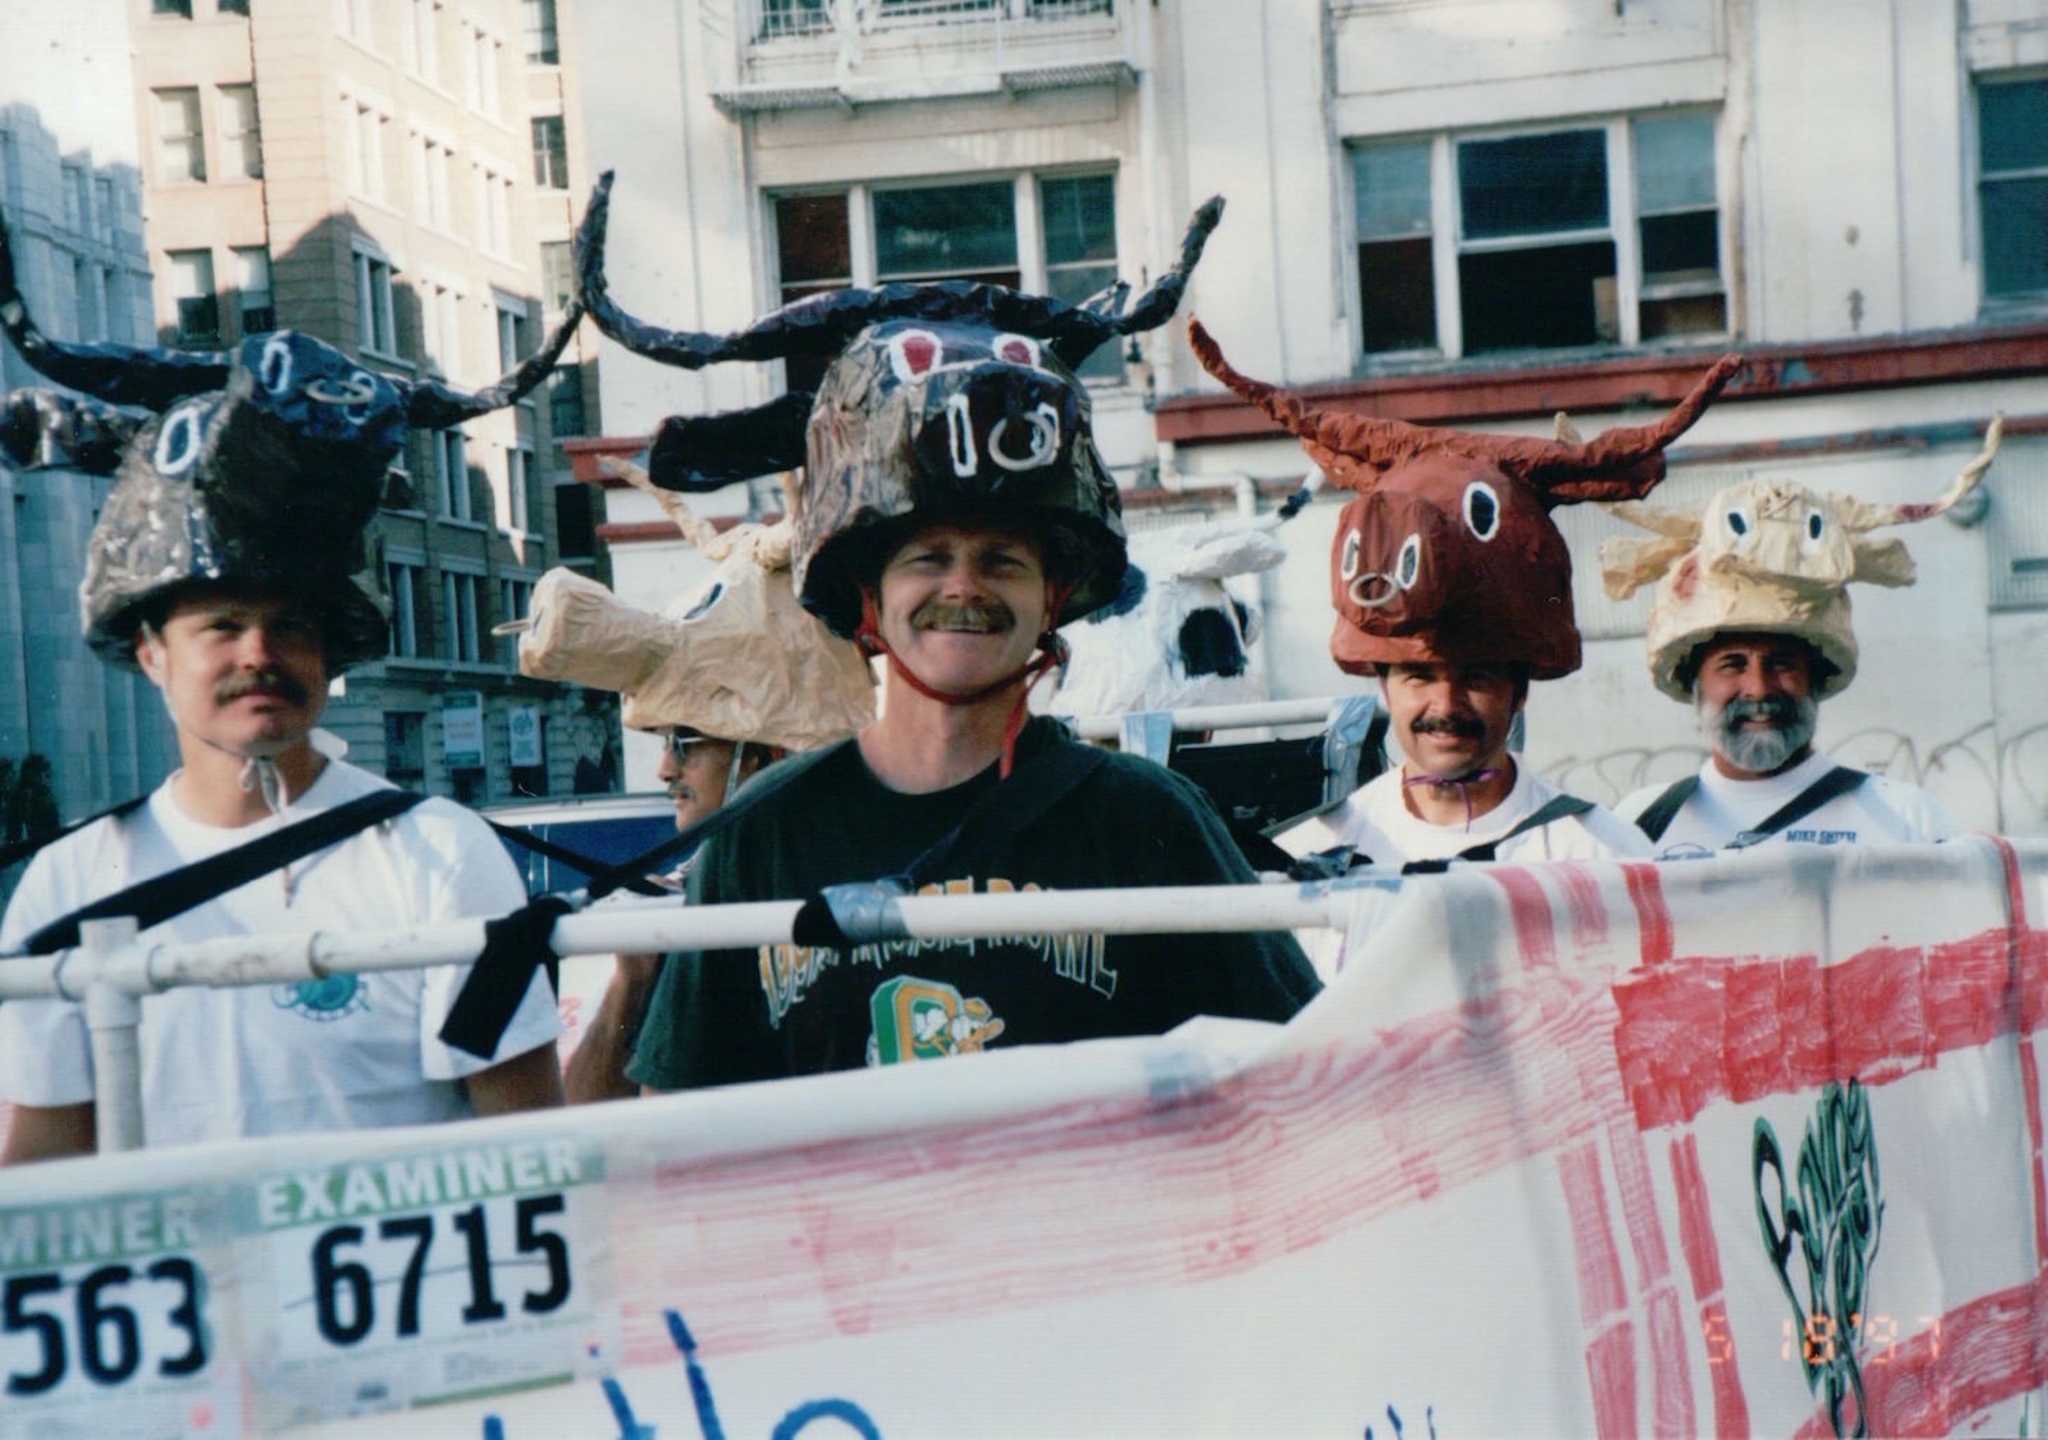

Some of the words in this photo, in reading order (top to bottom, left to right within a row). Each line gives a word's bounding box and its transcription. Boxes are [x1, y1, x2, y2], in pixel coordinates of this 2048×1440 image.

[260, 1143, 580, 1226] EXAMINER
[2, 1256, 211, 1396] 563
[311, 1194, 572, 1347] 6715
